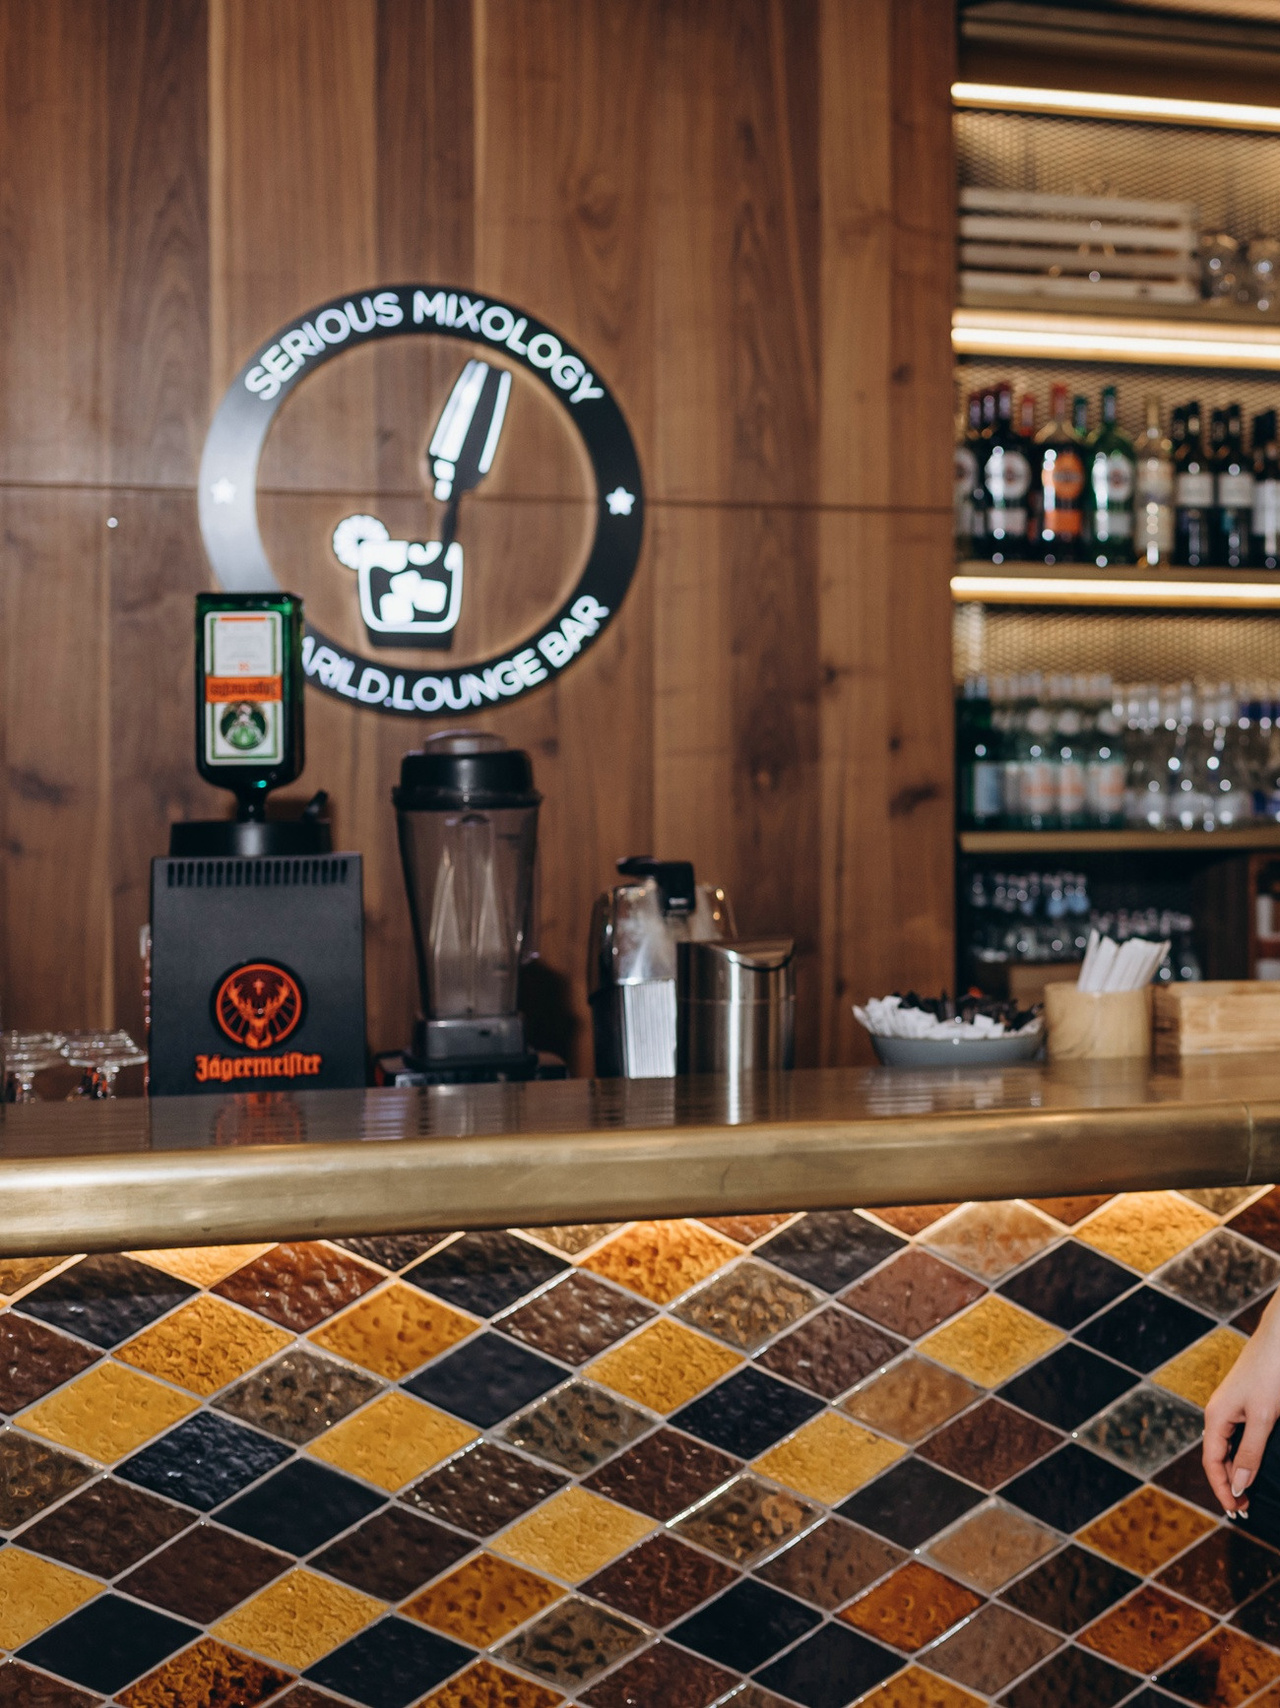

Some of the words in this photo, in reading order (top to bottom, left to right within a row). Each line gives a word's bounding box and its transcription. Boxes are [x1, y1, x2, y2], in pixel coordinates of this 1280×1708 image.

[244, 291, 403, 401] SERIOUS
[412, 291, 605, 404] MIXOLOGY
[538, 594, 610, 668] BAR
